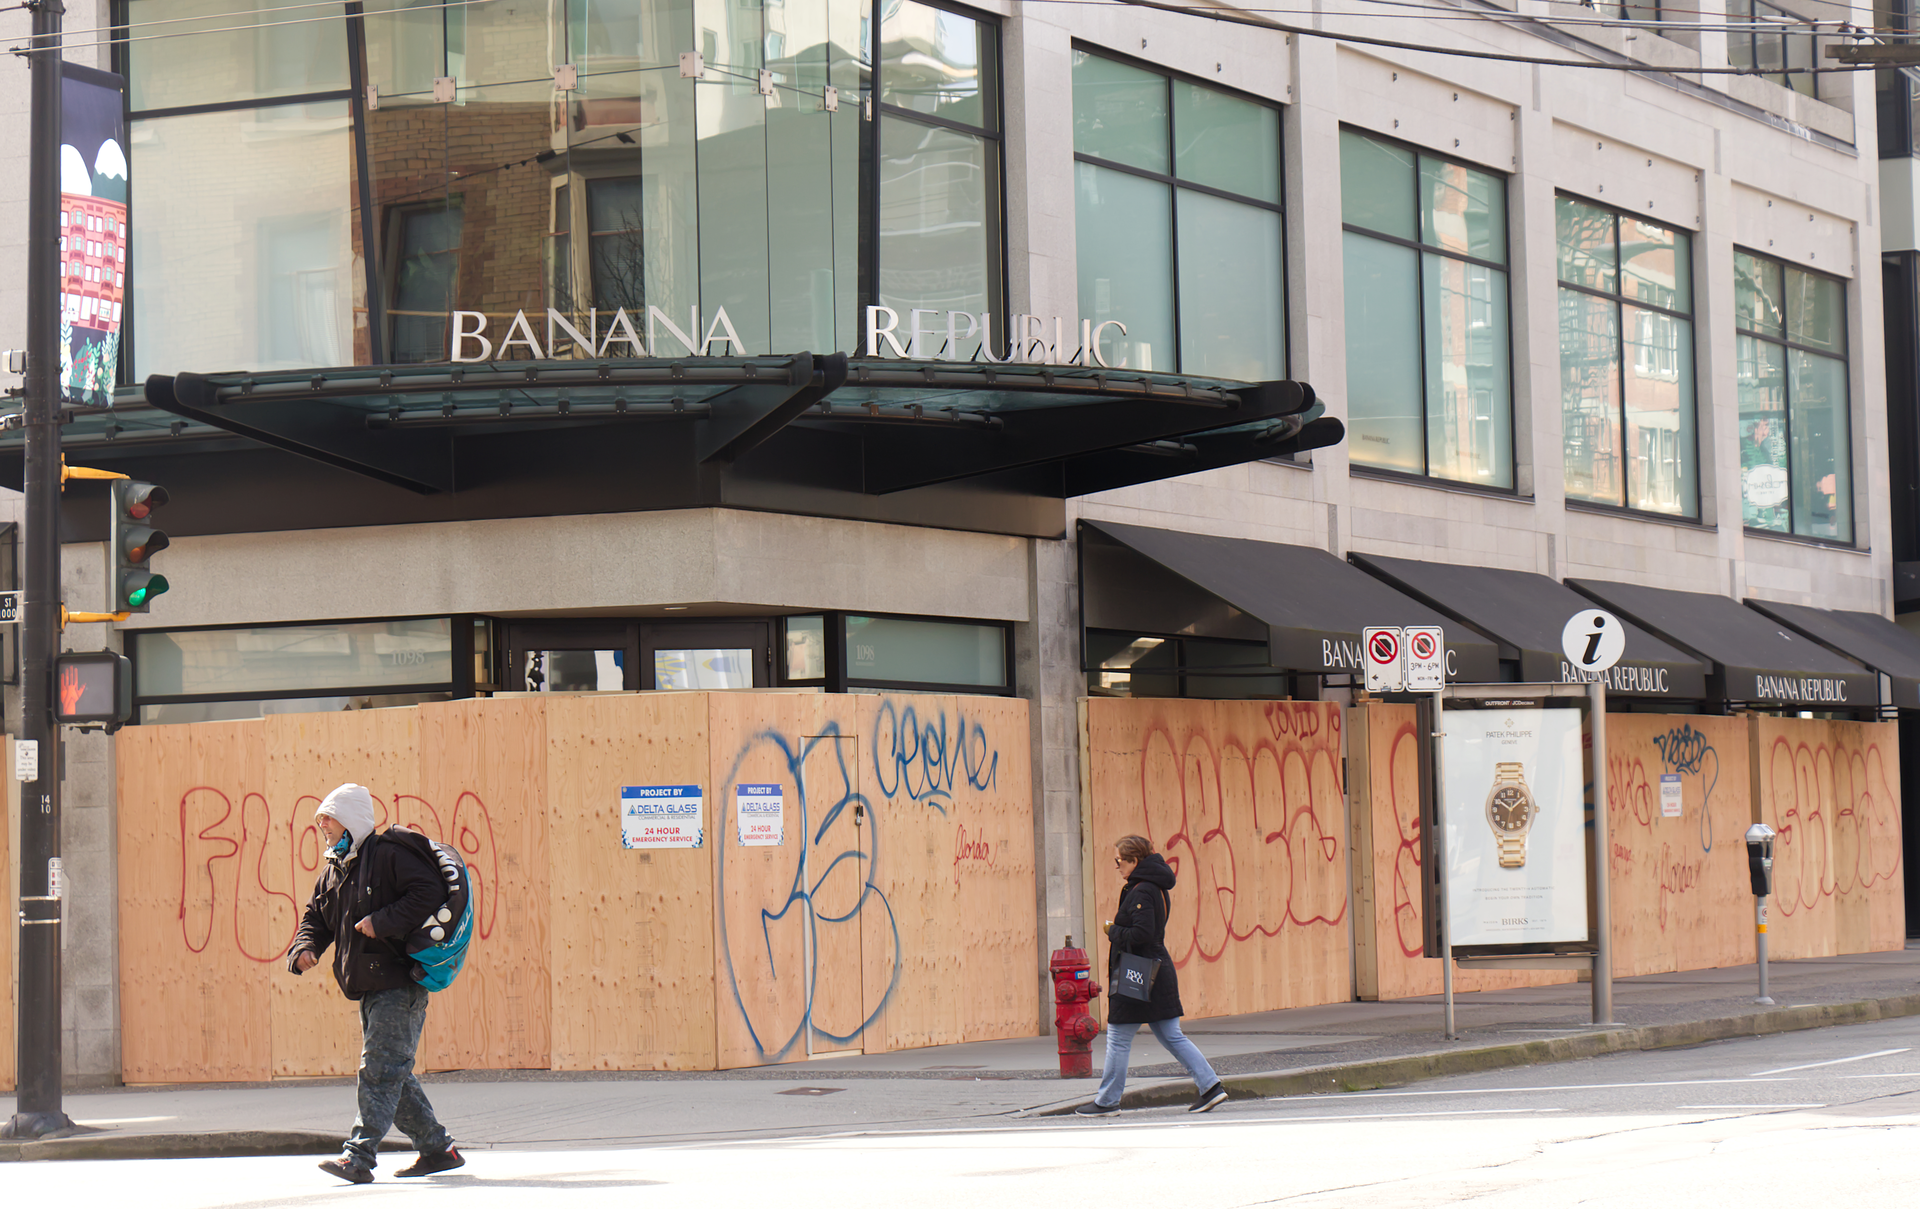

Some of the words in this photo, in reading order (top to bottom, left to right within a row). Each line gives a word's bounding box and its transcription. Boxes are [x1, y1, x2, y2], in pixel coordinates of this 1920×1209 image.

[451, 305, 747, 363] BANANA
[866, 305, 1127, 367] REPUBLIC
[5, 597, 12, 608] ST
[0, 608, 15, 618] 000
[391, 649, 425, 665] 1098
[856, 645, 875, 660] 1098
[1322, 639, 1365, 670] BANA
[1410, 662, 1422, 671] 3PM
[1427, 662, 1440, 671] 6PM
[1561, 661, 1613, 690] BANNA
[1613, 665, 1669, 693] REPUBLIC
[1756, 675, 1800, 700] BANANA
[1800, 679, 1847, 702] REPUBLIC
[1485, 731, 1505, 739] PATEK
[1505, 730, 1533, 738] PHILIPPE
[640, 789, 672, 797] PROJECT
[673, 788, 684, 796] BY
[41, 795, 50, 804] 14
[41, 804, 51, 814] 10
[637, 804, 665, 814] DELTA
[666, 804, 698, 814] GLASS
[746, 803, 762, 812] DELTA
[762, 803, 780, 812] GLASS
[644, 827, 654, 835] 24
[656, 827, 680, 835] HOUR
